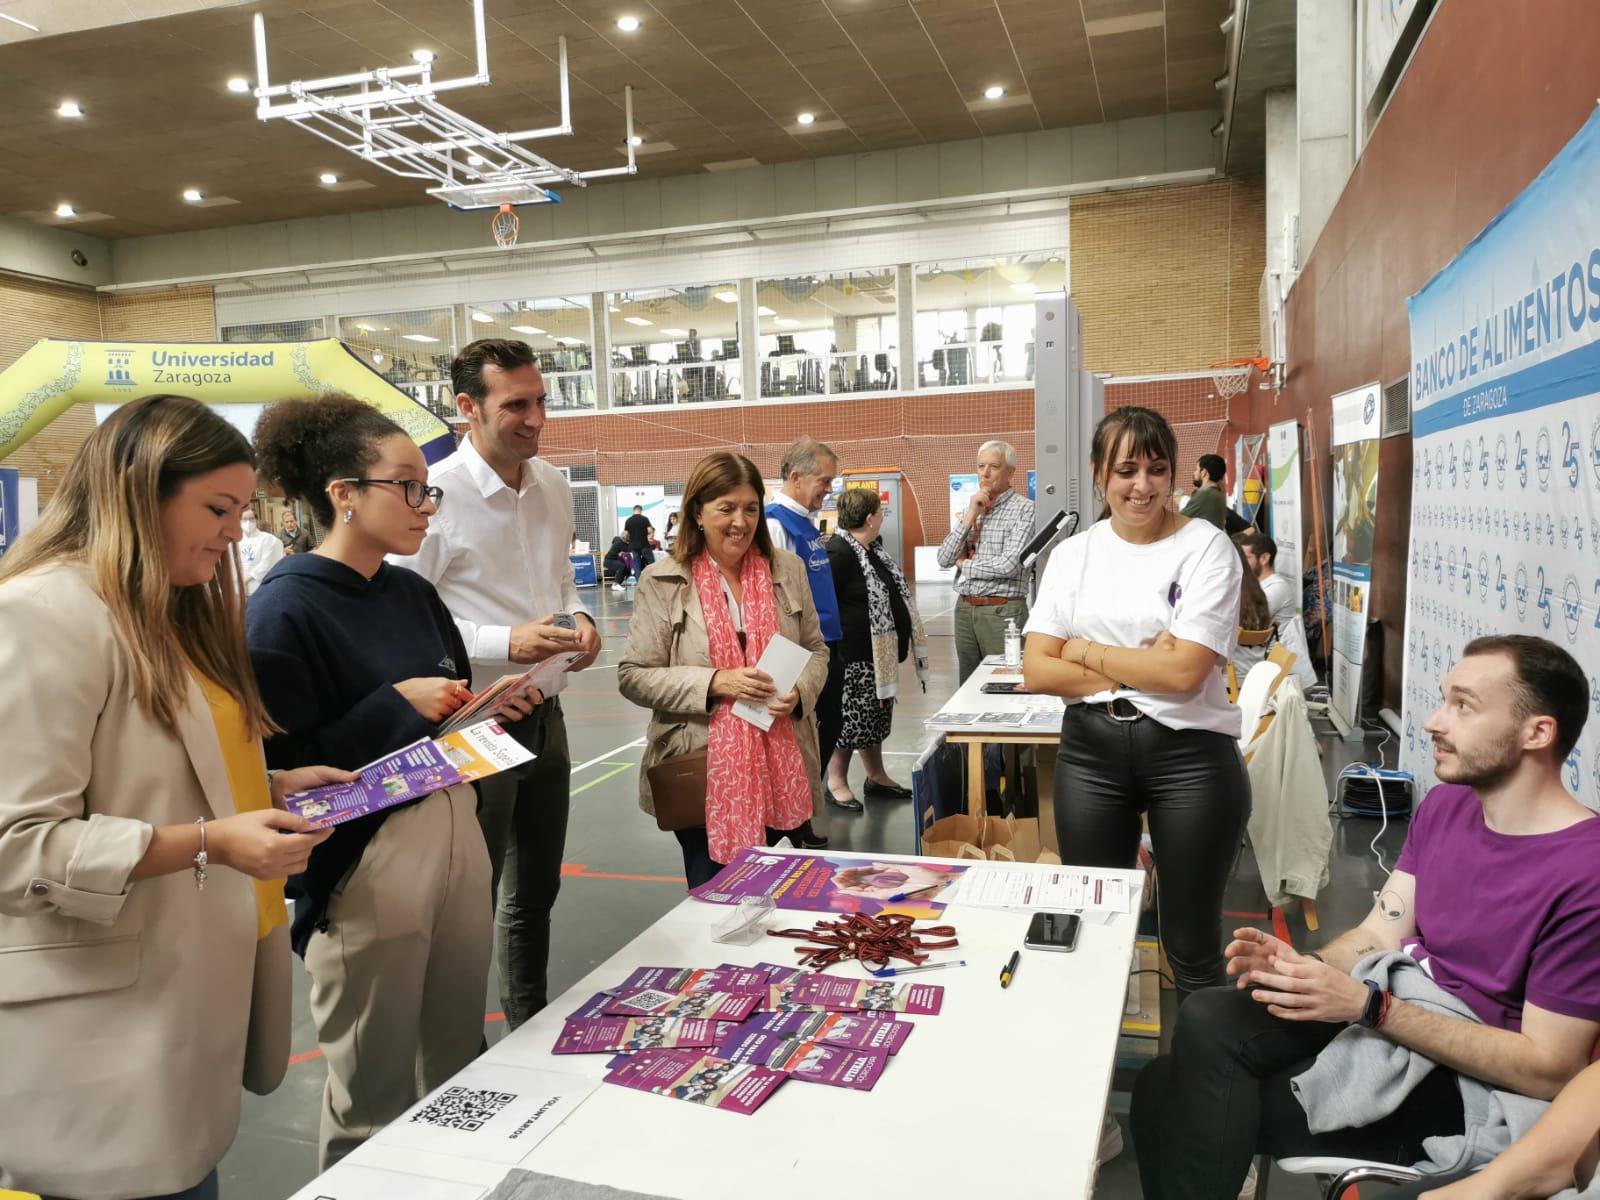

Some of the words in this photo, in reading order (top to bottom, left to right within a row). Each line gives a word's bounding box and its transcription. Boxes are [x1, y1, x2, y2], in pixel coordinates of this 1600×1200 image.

[1416, 342, 1455, 401] BANCO
[1459, 326, 1478, 381] DE
[1482, 248, 1600, 370] ALIMENTOS
[151, 350, 274, 367] Universidad
[153, 370, 232, 386] Zaragoza
[1463, 399, 1472, 417] DE
[1472, 386, 1508, 415] ZARAGOZA
[1478, 435, 1489, 487] 25
[1515, 430, 1528, 488] 25
[1562, 420, 1580, 489] 25
[846, 480, 877, 490] IMPLANTE
[1496, 554, 1507, 610] 25
[1537, 565, 1552, 630] 25
[842, 1057, 868, 1082] UTRILLO
[508, 1096, 562, 1139] VOLUNTARIOS
